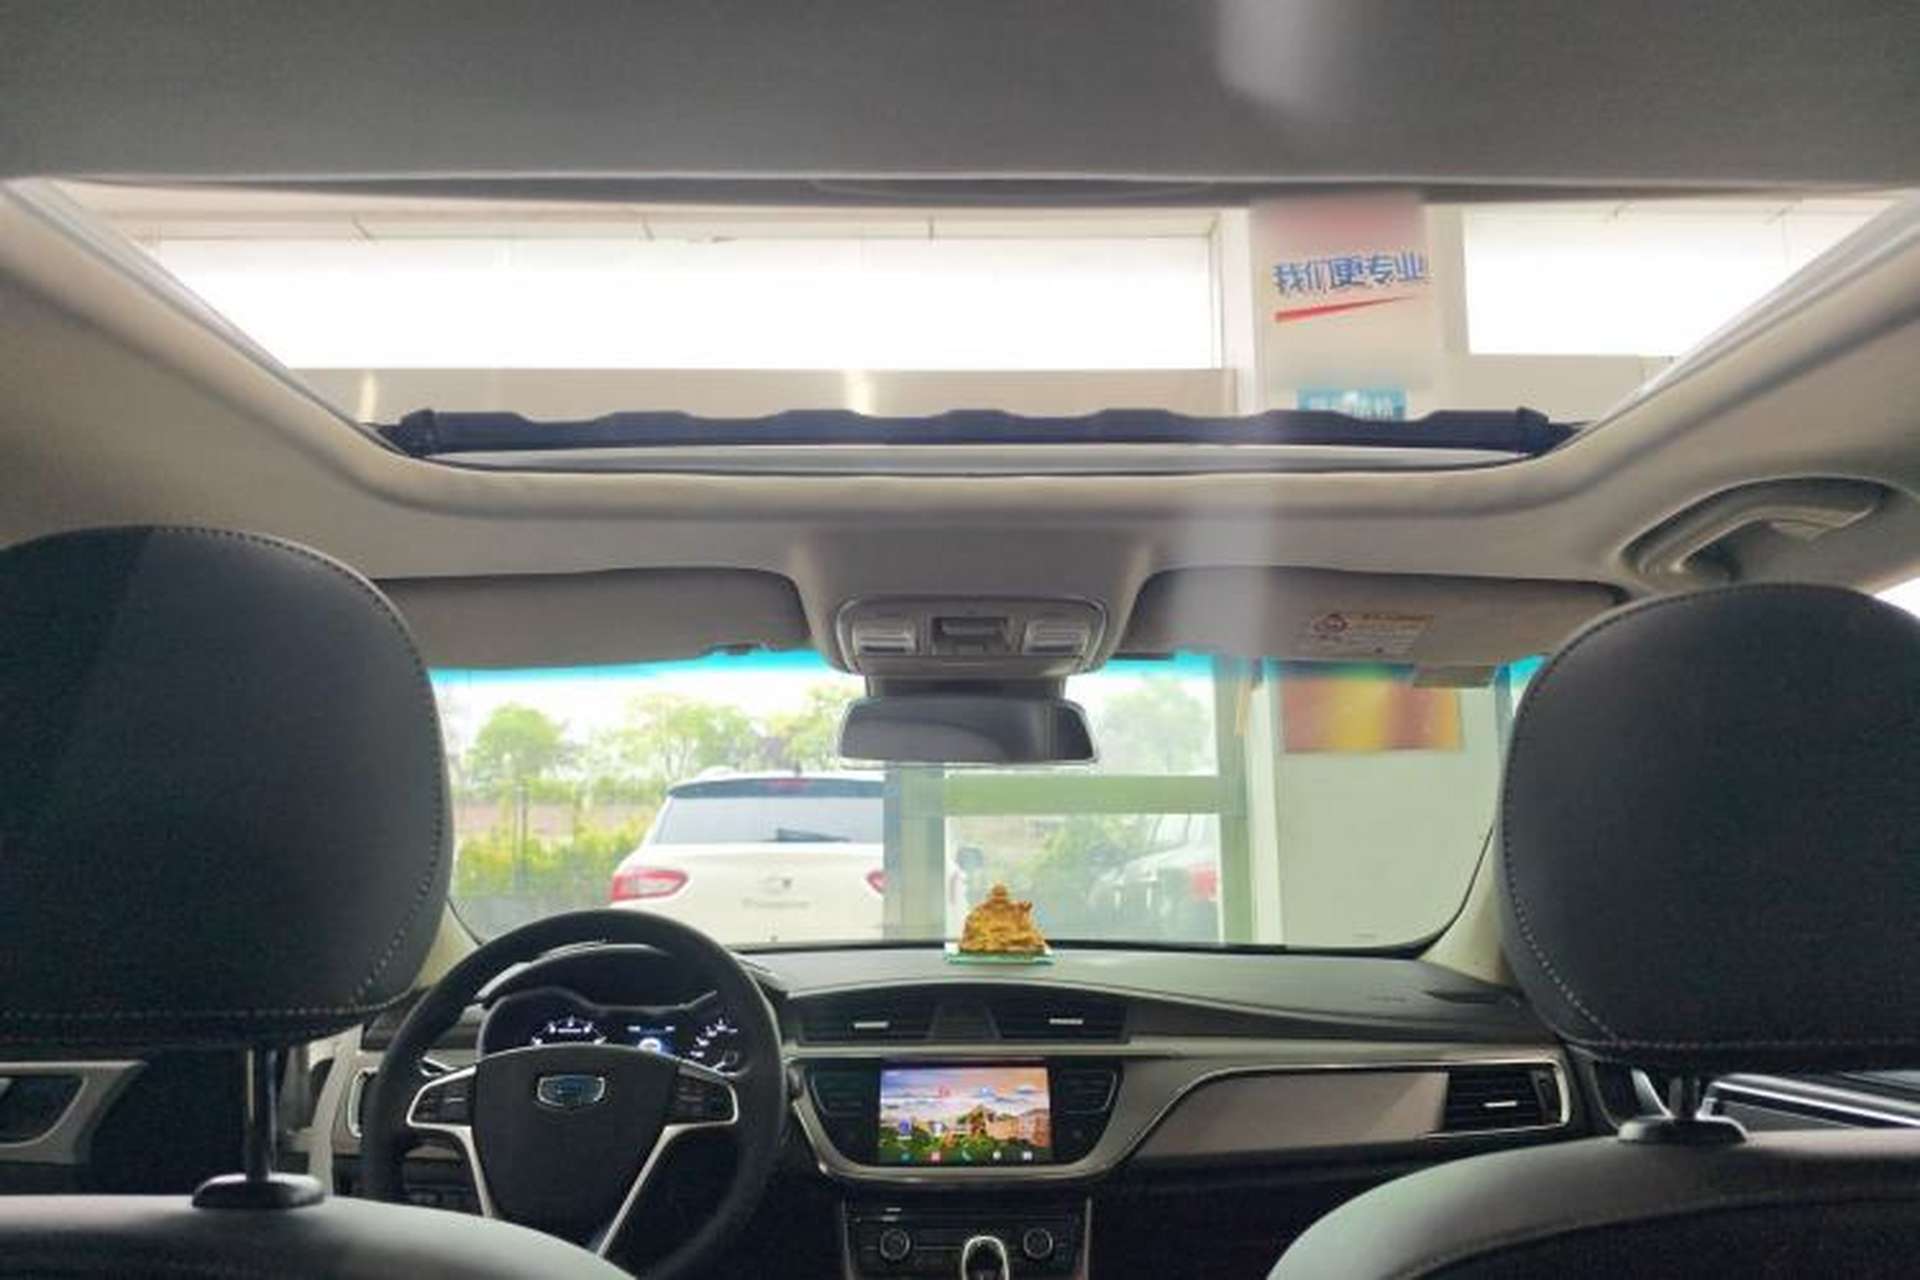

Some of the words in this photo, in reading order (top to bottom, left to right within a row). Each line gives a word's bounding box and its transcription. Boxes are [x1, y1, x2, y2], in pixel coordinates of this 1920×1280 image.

[1273, 252, 1429, 294] 我们更专业
